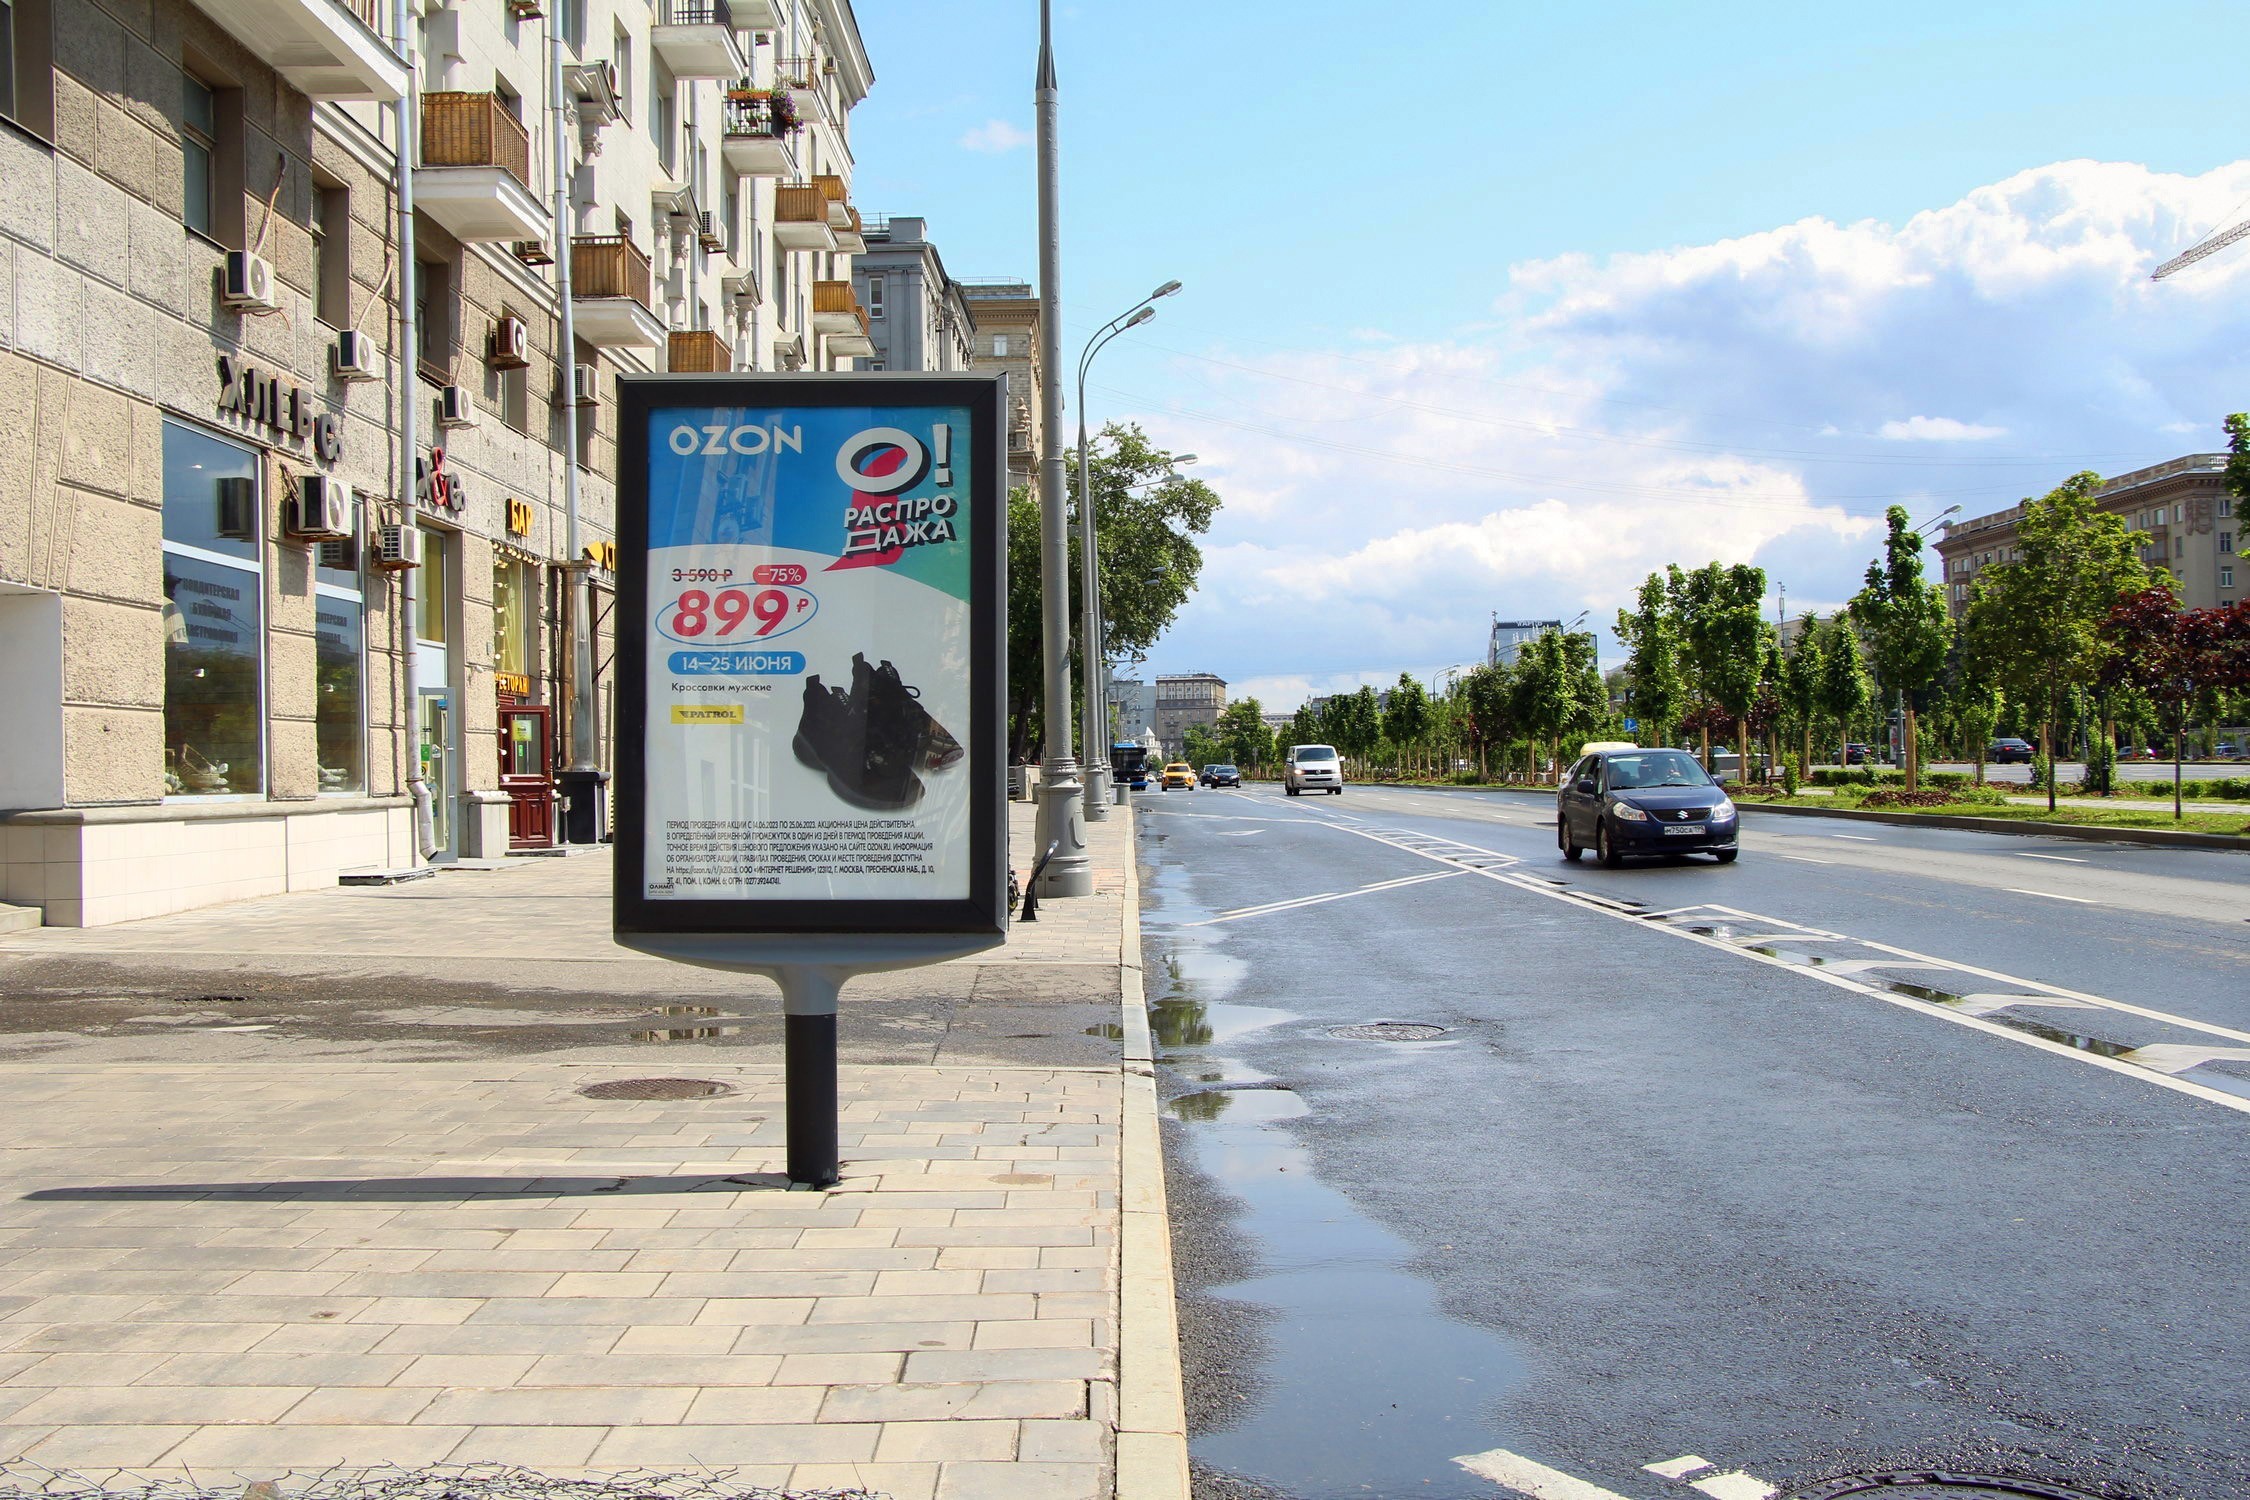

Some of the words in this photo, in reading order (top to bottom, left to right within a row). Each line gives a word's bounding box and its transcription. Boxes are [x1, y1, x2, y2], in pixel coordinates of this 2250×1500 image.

[218, 355, 314, 439] ХЛЕБ
[669, 424, 803, 455] OZON
[506, 497, 534, 537] БАР
[843, 494, 957, 529] РАСПРО
[842, 518, 957, 557] ДАЖА
[688, 568, 718, 582] 590
[672, 589, 789, 637] 899
[735, 656, 792, 671] ИЮНЯ
[671, 682, 725, 693] Кроссовки
[728, 683, 772, 693] мужские
[689, 710, 736, 719] PATROL
[666, 820, 689, 830] ПЕРИОД
[690, 820, 727, 830] ПРОВЕДЕНИЯ
[727, 820, 747, 830] АКЦИИ
[779, 820, 788, 830] ПО
[818, 820, 852, 830] АКЦИОННАЯ
[853, 820, 868, 830] ЦЕНА
[869, 820, 915, 830] ДЕЙСТВИТЕЛЬНА
[666, 831, 671, 841] В
[717, 831, 751, 841] ВРЕМЕННОЙ
[752, 831, 791, 841] ПРОМЕЖУТОК
[797, 831, 813, 841] ОДИН
[814, 831, 822, 841] ИЗ
[823, 831, 838, 841] ДНЕЙ
[844, 831, 866, 841] ПЕРИОД
[867, 831, 902, 841] ПРОВЕДЕНИЯ
[666, 842, 688, 852] ТОЧНОЕ
[690, 842, 707, 852] ВРЕМЯ
[708, 842, 737, 852] ДЕЙСТВИЯ
[738, 842, 768, 852] ЦЕНОВОГО
[769, 842, 811, 852] ПРЕДЛОЖЕНИЯ
[811, 842, 838, 852] УКАЗАНО
[839, 842, 848, 852] НА
[848, 842, 866, 852] САЙТЕ
[893, 842, 933, 852] ИНФОРМАЦИЯ
[666, 854, 675, 864] ОБ
[675, 854, 717, 864] ОРГАНИЗАТОРЕ
[739, 854, 769, 864] ПРАВИЛАХ
[808, 854, 831, 864] СРОКАХ
[837, 854, 855, 864] МЕСТЕ
[855, 854, 891, 864] ПРОВЕДЕНИЯ
[892, 854, 923, 864] ДОСТУПНА
[666, 865, 675, 876] НА
[739, 865, 752, 876] ООО
[865, 865, 906, 876] ПРЕСНЕНСКАЯ
[728, 876, 743, 886] ОГРН
